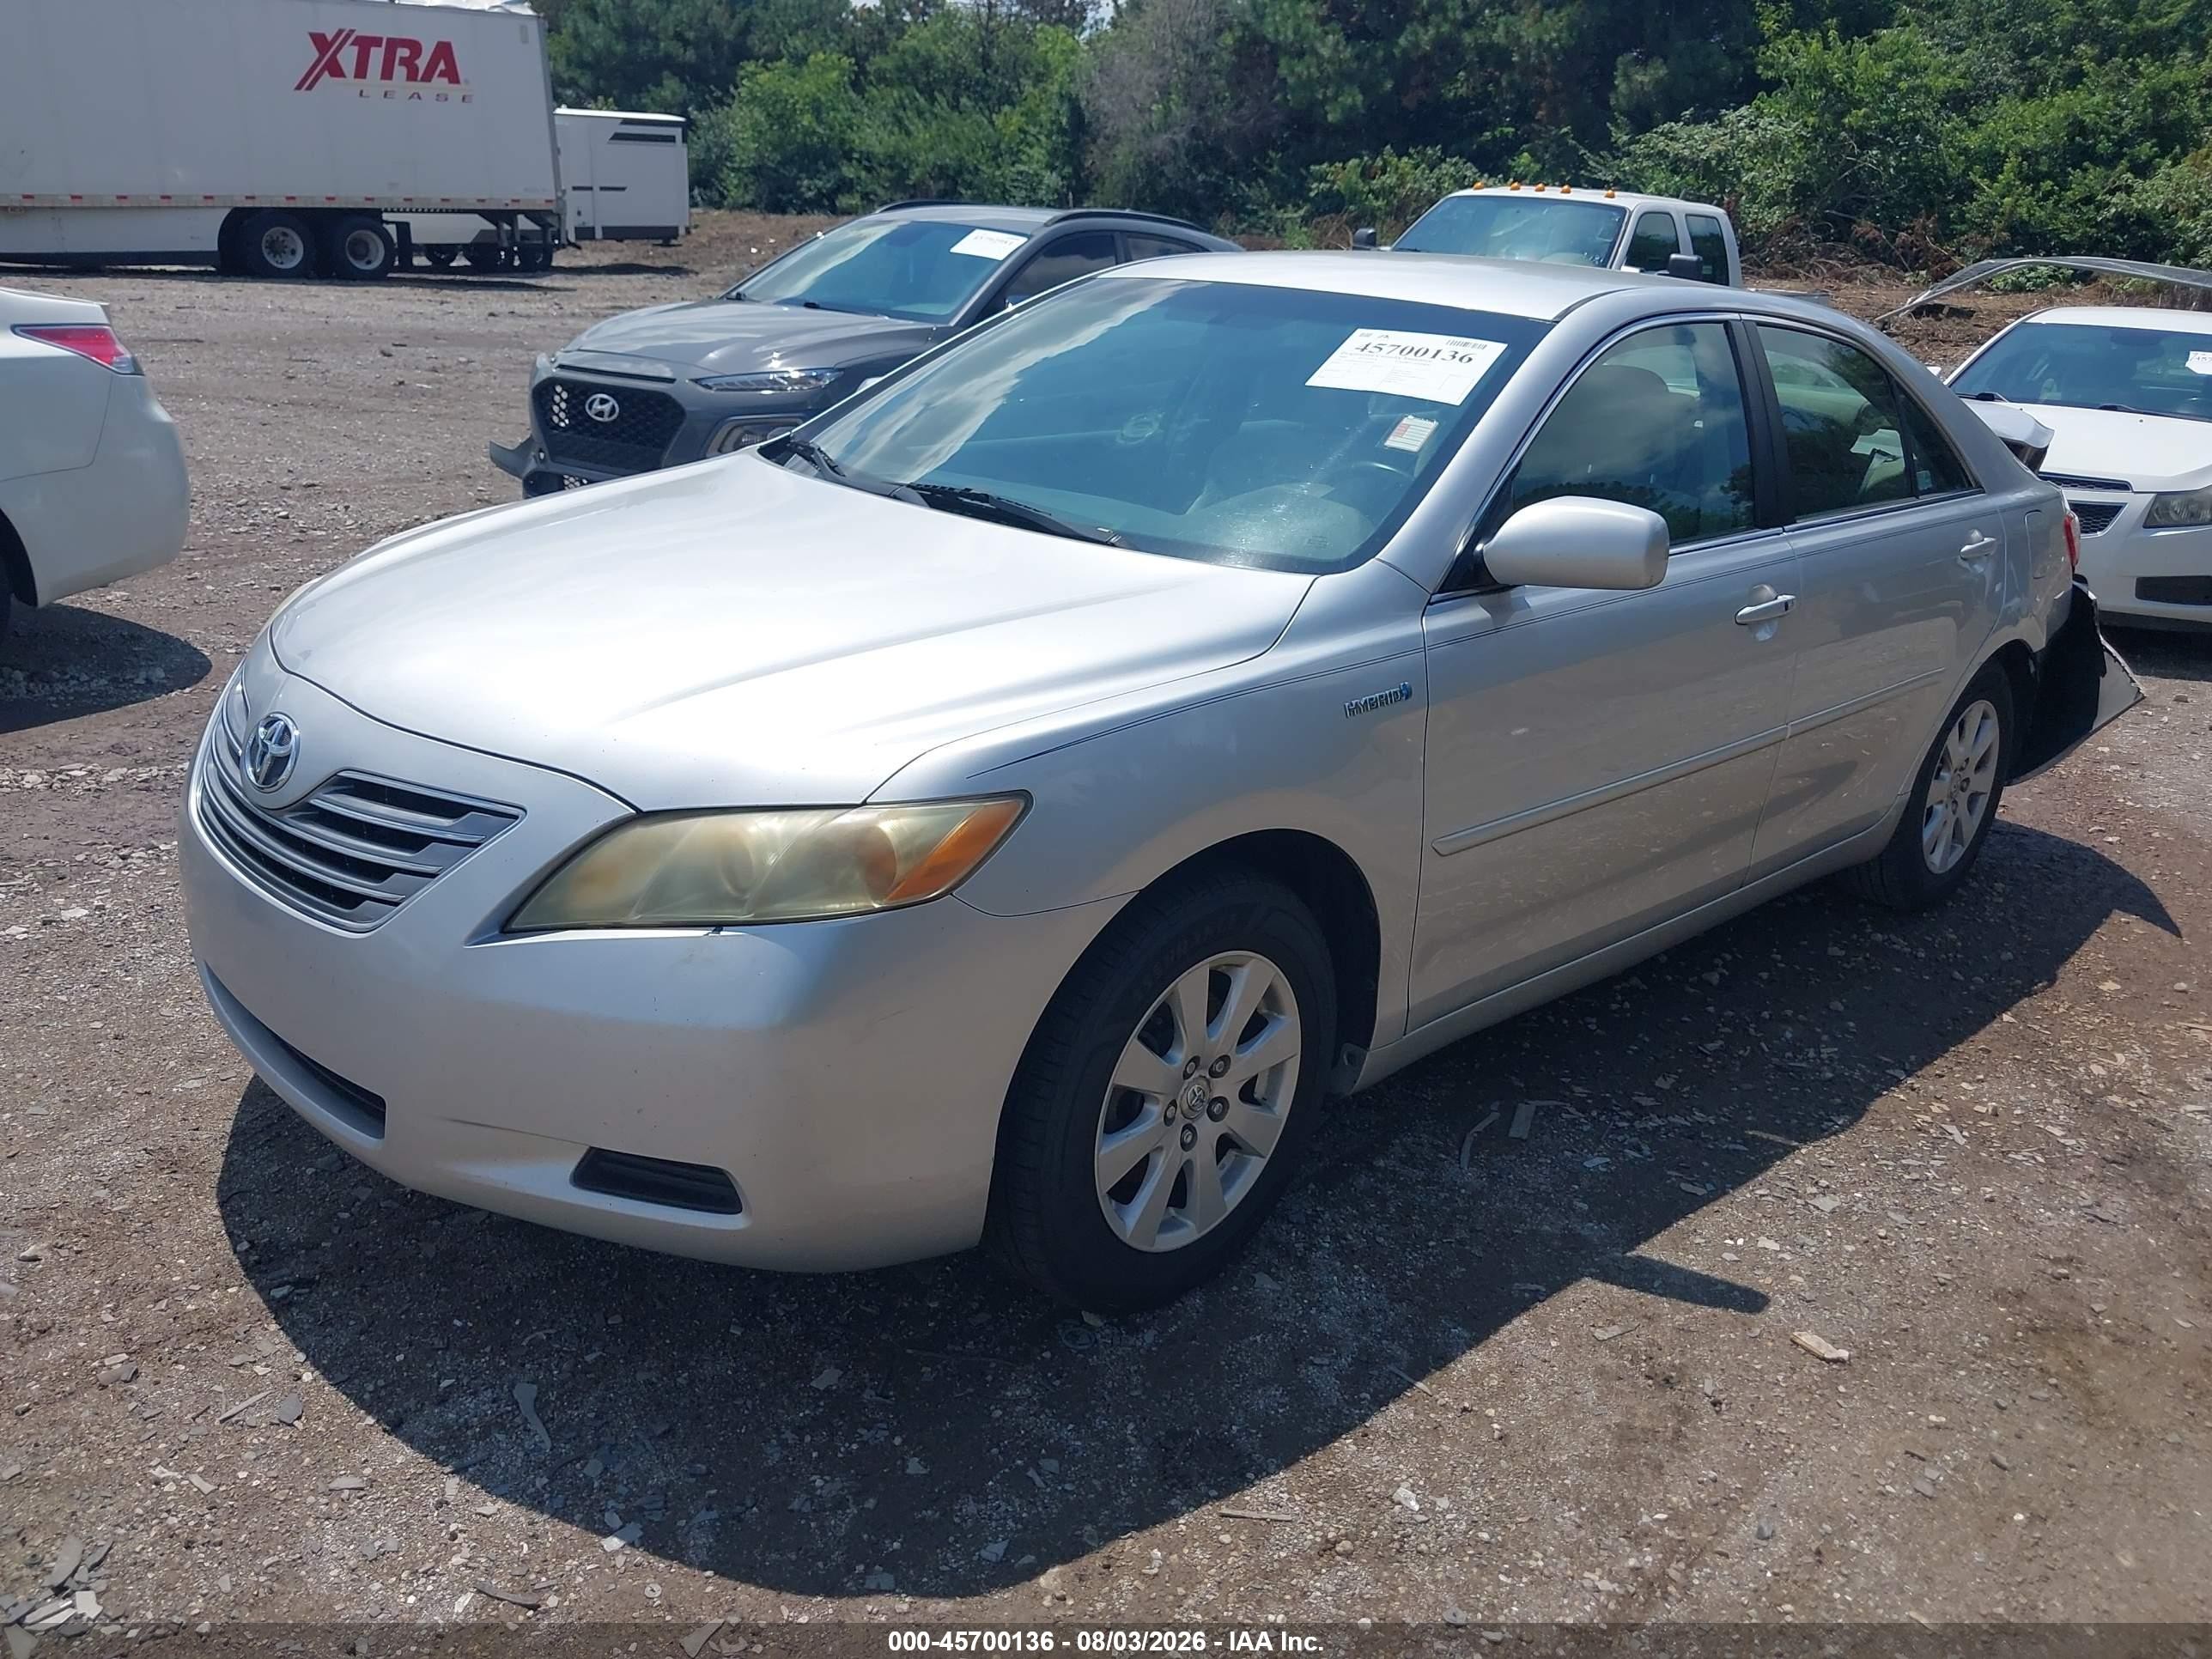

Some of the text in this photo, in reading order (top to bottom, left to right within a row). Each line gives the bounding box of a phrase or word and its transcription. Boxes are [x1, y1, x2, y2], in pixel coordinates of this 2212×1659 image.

[294, 28, 461, 91] XTRA
[359, 89, 473, 103] LEASE
[1355, 342, 1477, 363] 45700136
[1344, 688, 1402, 718] HYBRID
